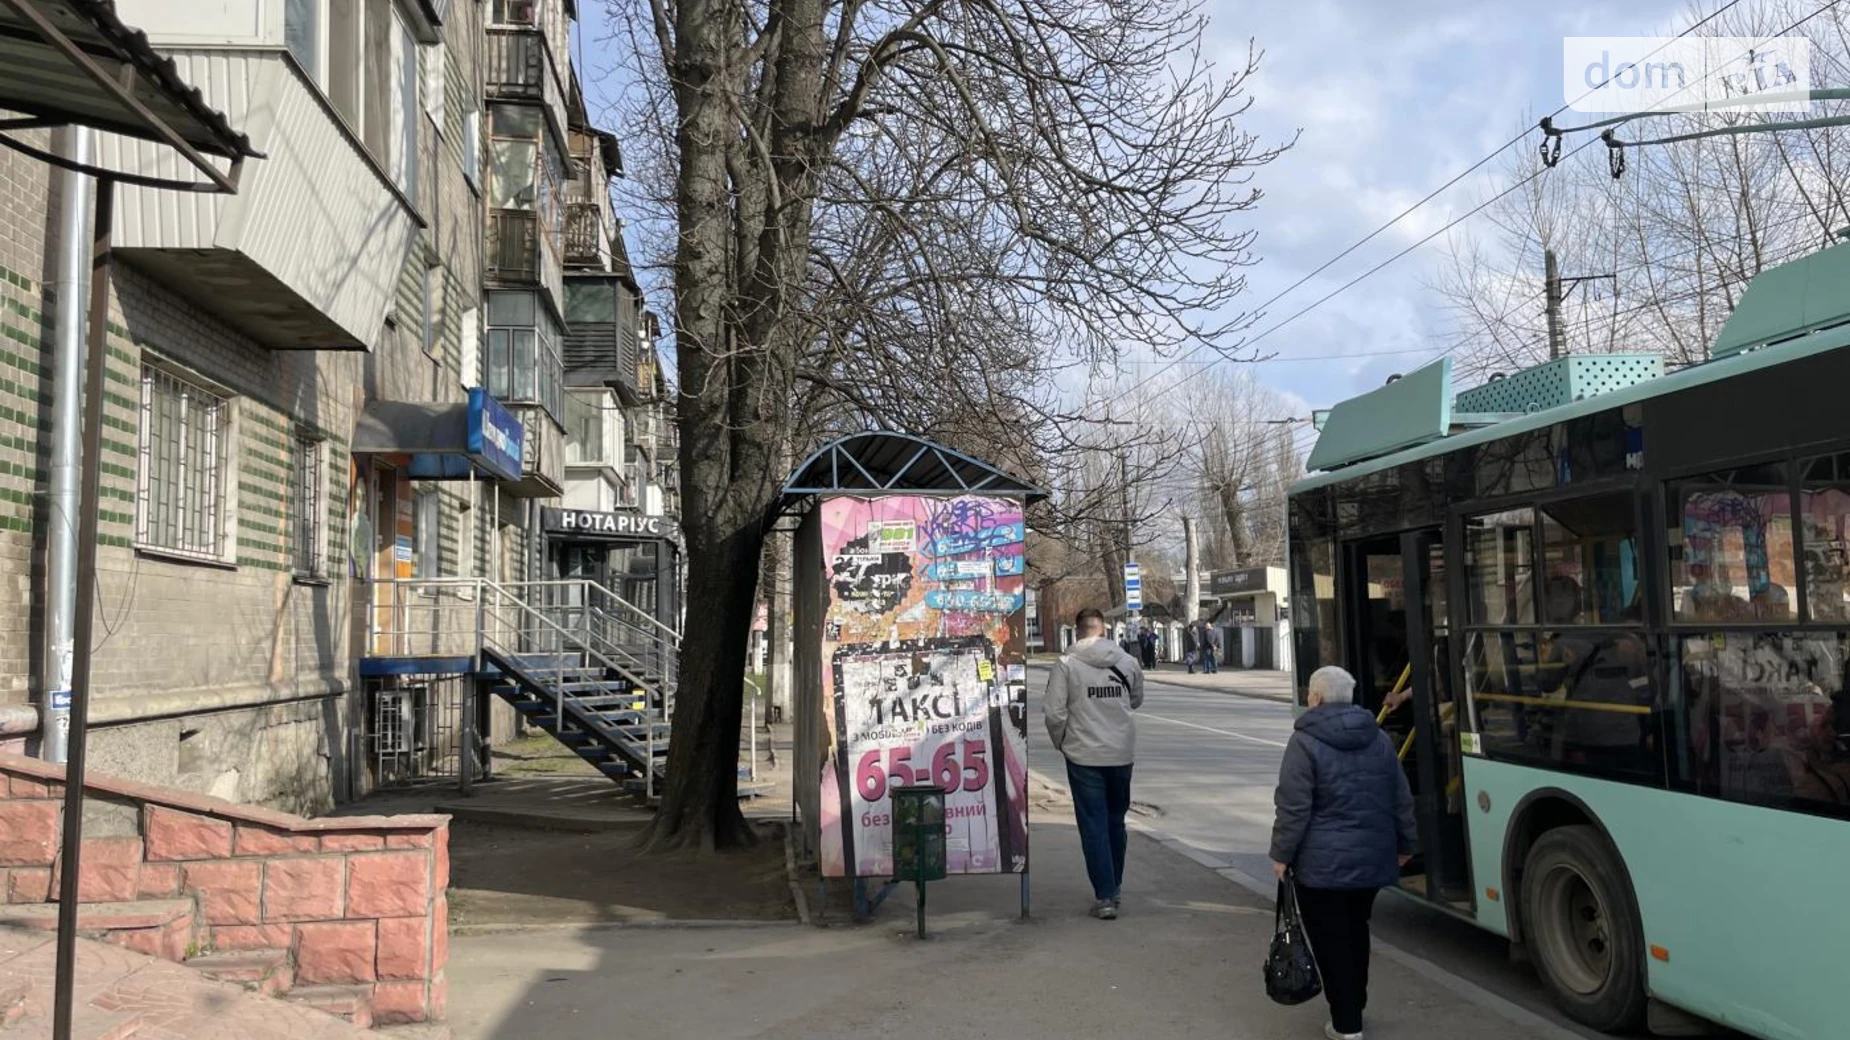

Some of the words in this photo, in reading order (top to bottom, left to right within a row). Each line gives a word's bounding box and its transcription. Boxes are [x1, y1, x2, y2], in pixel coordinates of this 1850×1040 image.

[562, 511, 659, 533] НОТАРІУС
[1087, 686, 1122, 698] PUMA
[868, 692, 962, 725] ТАКСІ
[932, 724, 950, 734] БЕЗ
[952, 721, 983, 733] КОДІВ
[856, 739, 989, 802] 65-65
